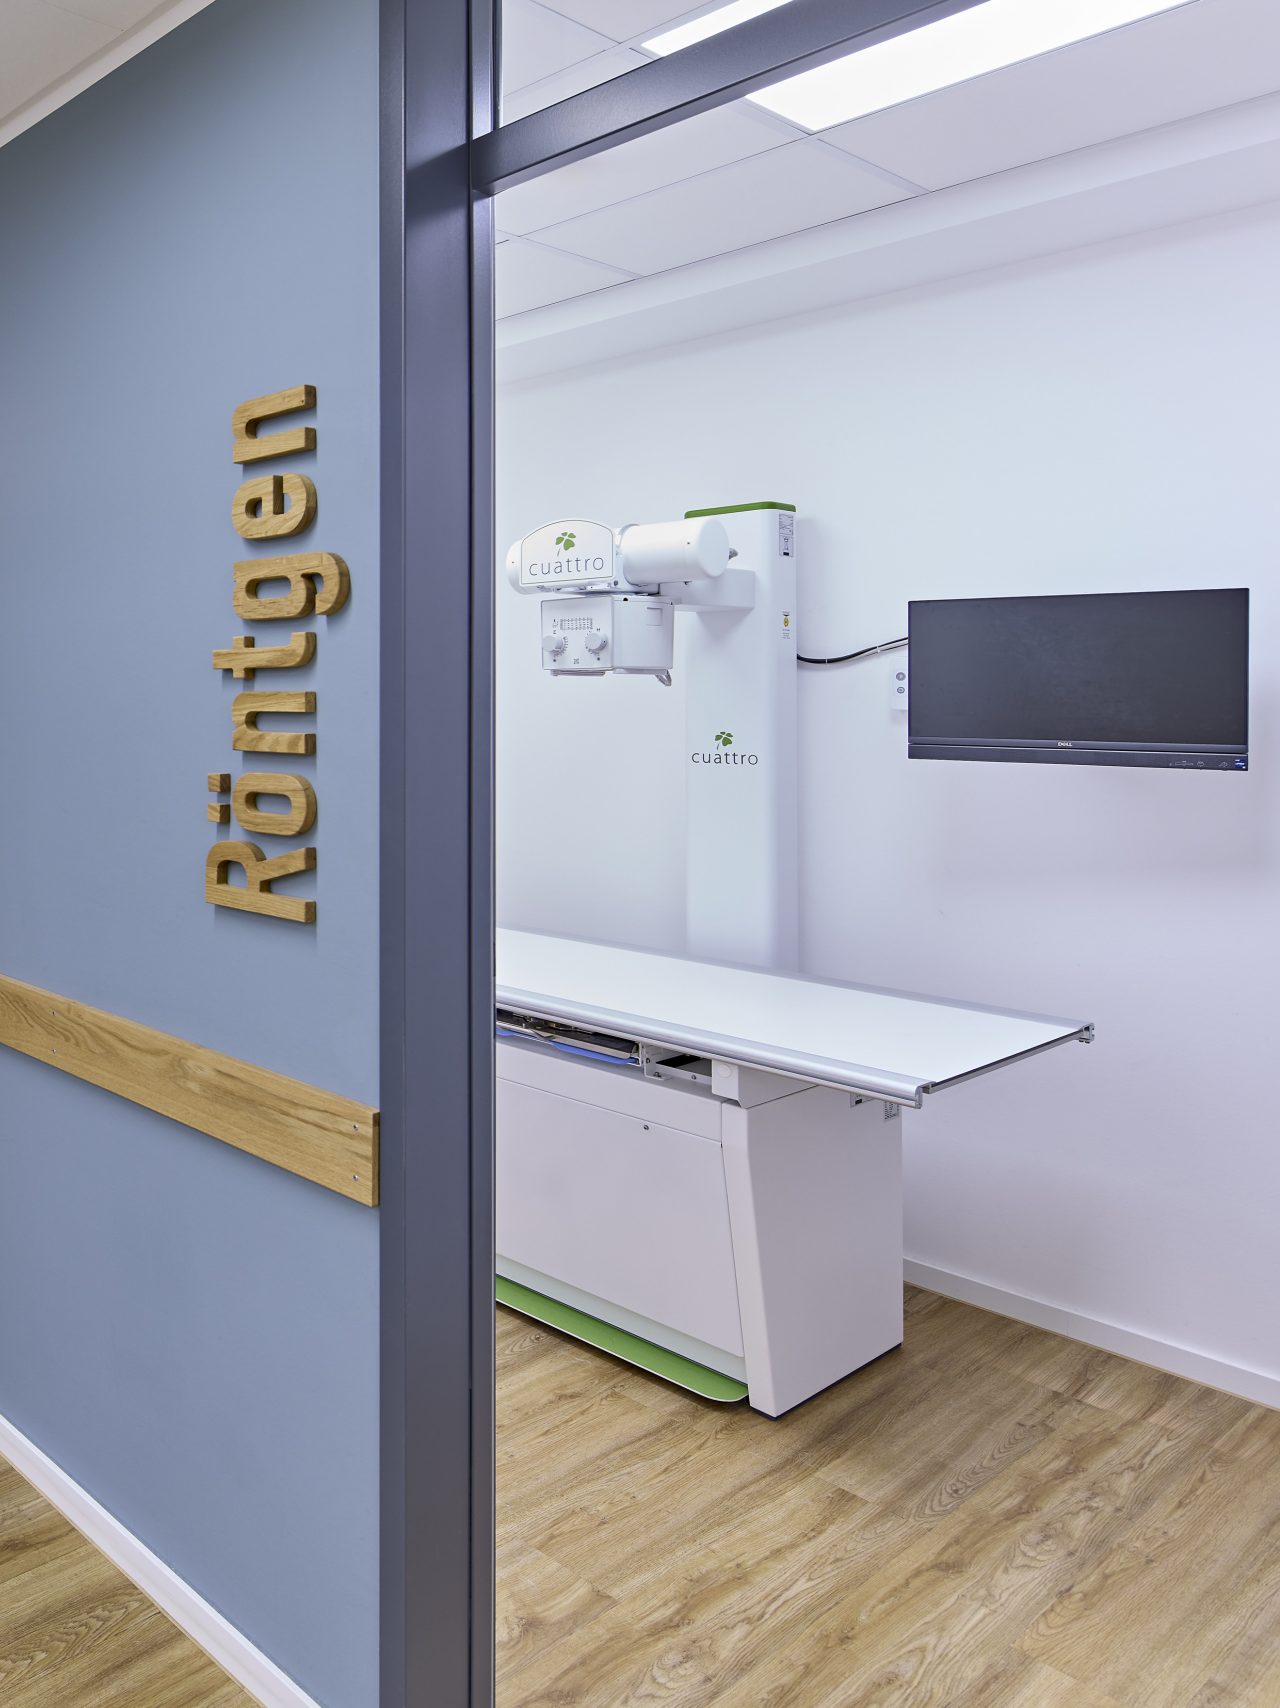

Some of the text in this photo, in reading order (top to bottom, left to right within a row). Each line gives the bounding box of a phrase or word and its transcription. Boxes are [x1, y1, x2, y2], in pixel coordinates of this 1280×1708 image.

[529, 557, 604, 576] cuattro
[205, 384, 352, 924] Röntgen
[691, 752, 759, 766] cuattro
